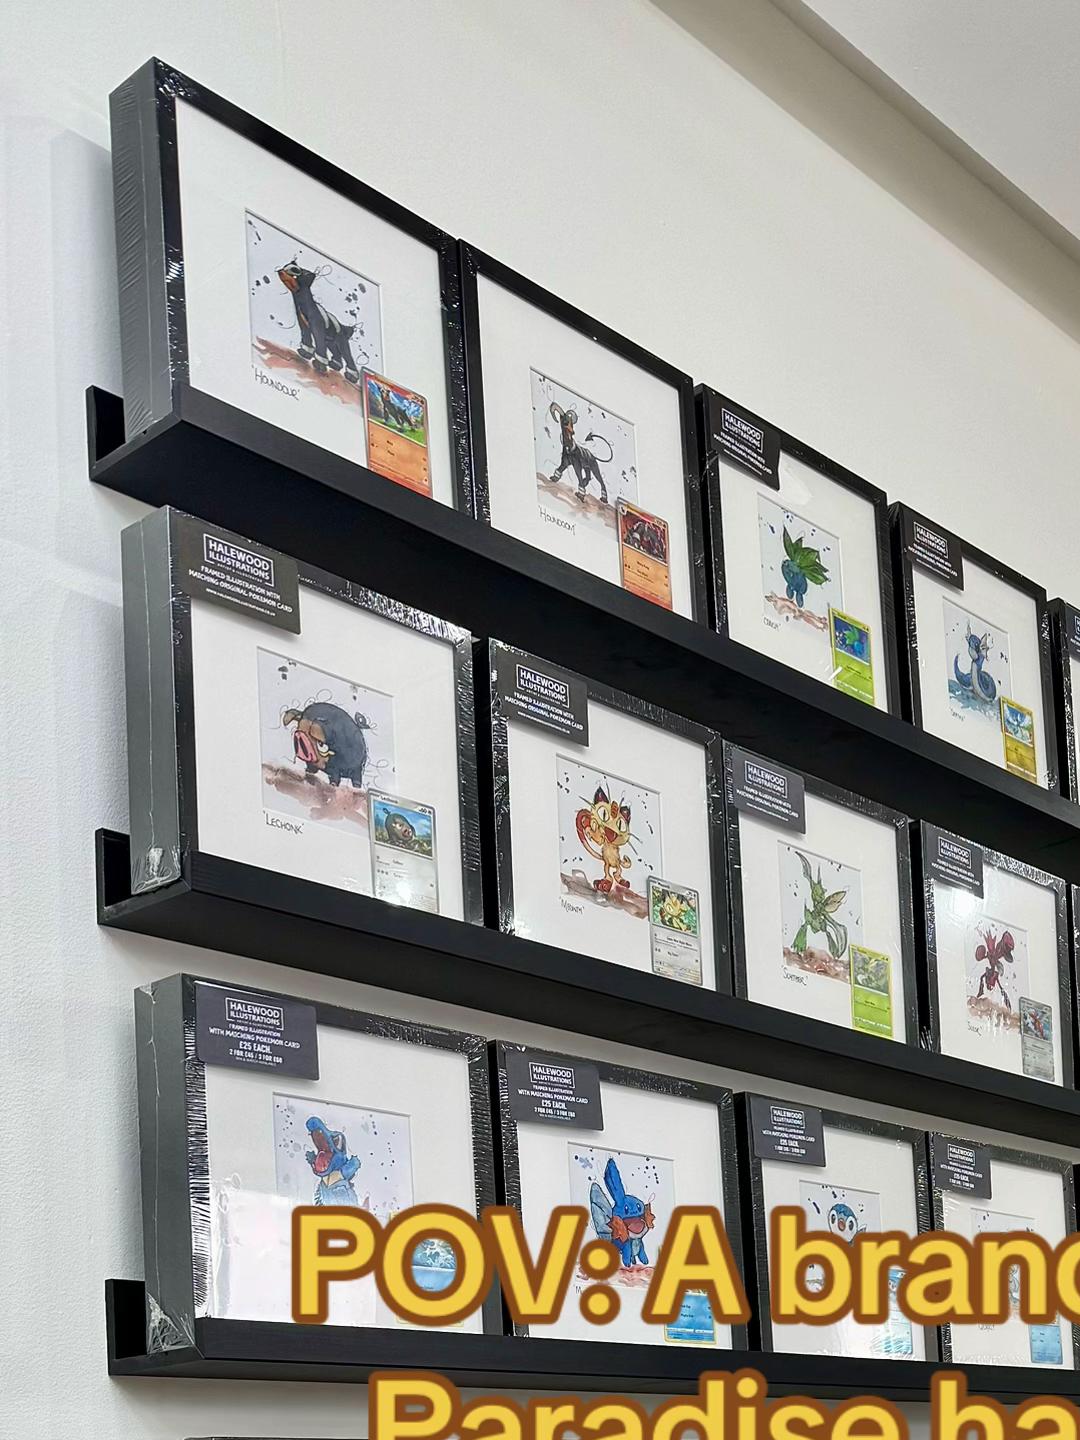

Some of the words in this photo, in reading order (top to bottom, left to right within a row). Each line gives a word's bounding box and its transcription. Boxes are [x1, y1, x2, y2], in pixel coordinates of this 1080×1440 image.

[724, 412, 761, 441] HALEWOOD
[916, 525, 946, 548] HALEWOOD
[208, 538, 269, 571] HALEWOOD
[208, 549, 270, 580] ILLUSTRATIONS
[519, 668, 566, 694] HALEWOOD
[520, 678, 566, 702] ILLUSTRATIONS
[747, 764, 784, 786] HALEWOOD
[748, 772, 785, 793] ILLUSTRATIONS
[940, 839, 969, 858] HALEWOOD
[229, 1001, 280, 1018] HALEWOOD
[229, 1010, 280, 1026] ILLUSTRATIONS
[283, 1039, 300, 1049] CARD
[531, 1065, 571, 1078] HALEWOOD
[532, 1072, 572, 1084] ILLUSTRATIONS
[772, 1108, 802, 1119] HALEWOOD
[949, 1146, 973, 1157] HALEWOOD
